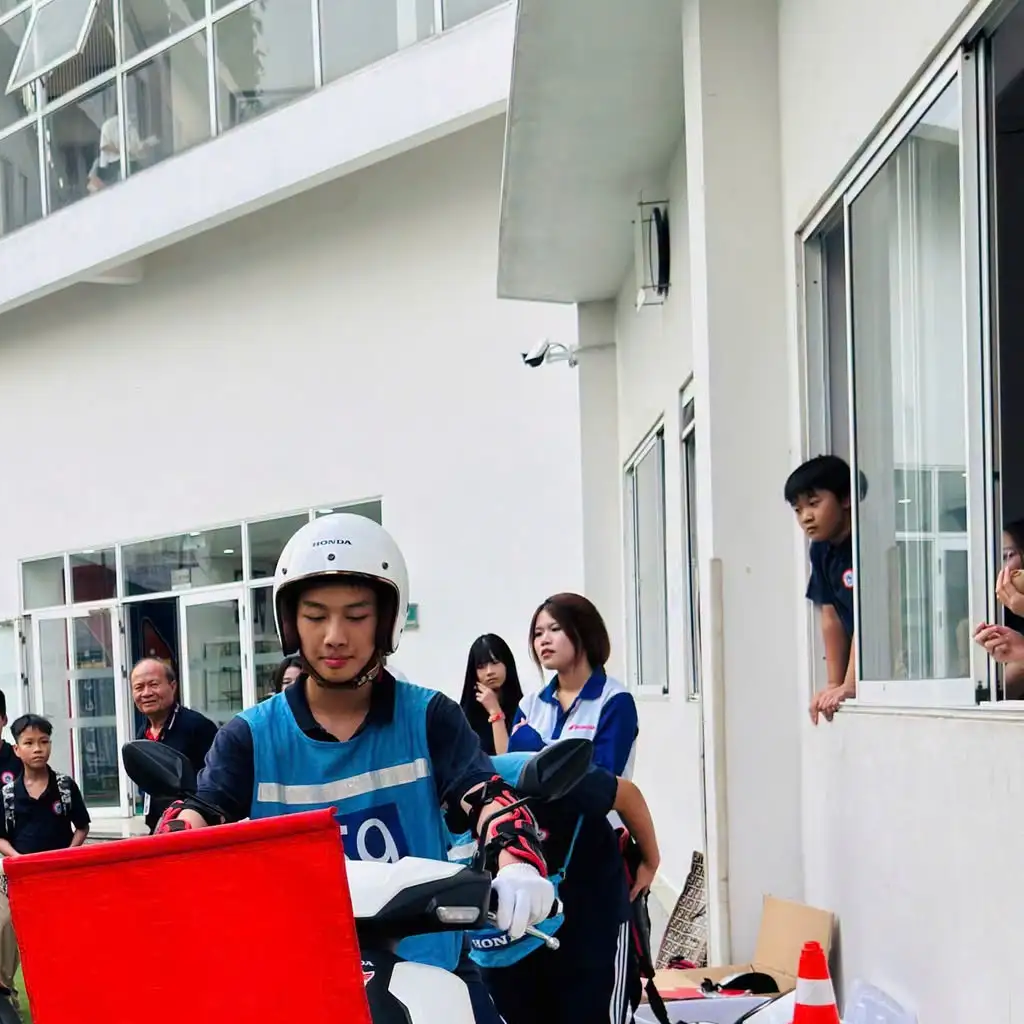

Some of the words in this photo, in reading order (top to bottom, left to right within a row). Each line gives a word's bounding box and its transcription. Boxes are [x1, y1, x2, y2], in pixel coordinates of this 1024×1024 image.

[312, 539, 353, 548] HONDA
[340, 818, 400, 863] 9
[472, 934, 510, 950] HON
